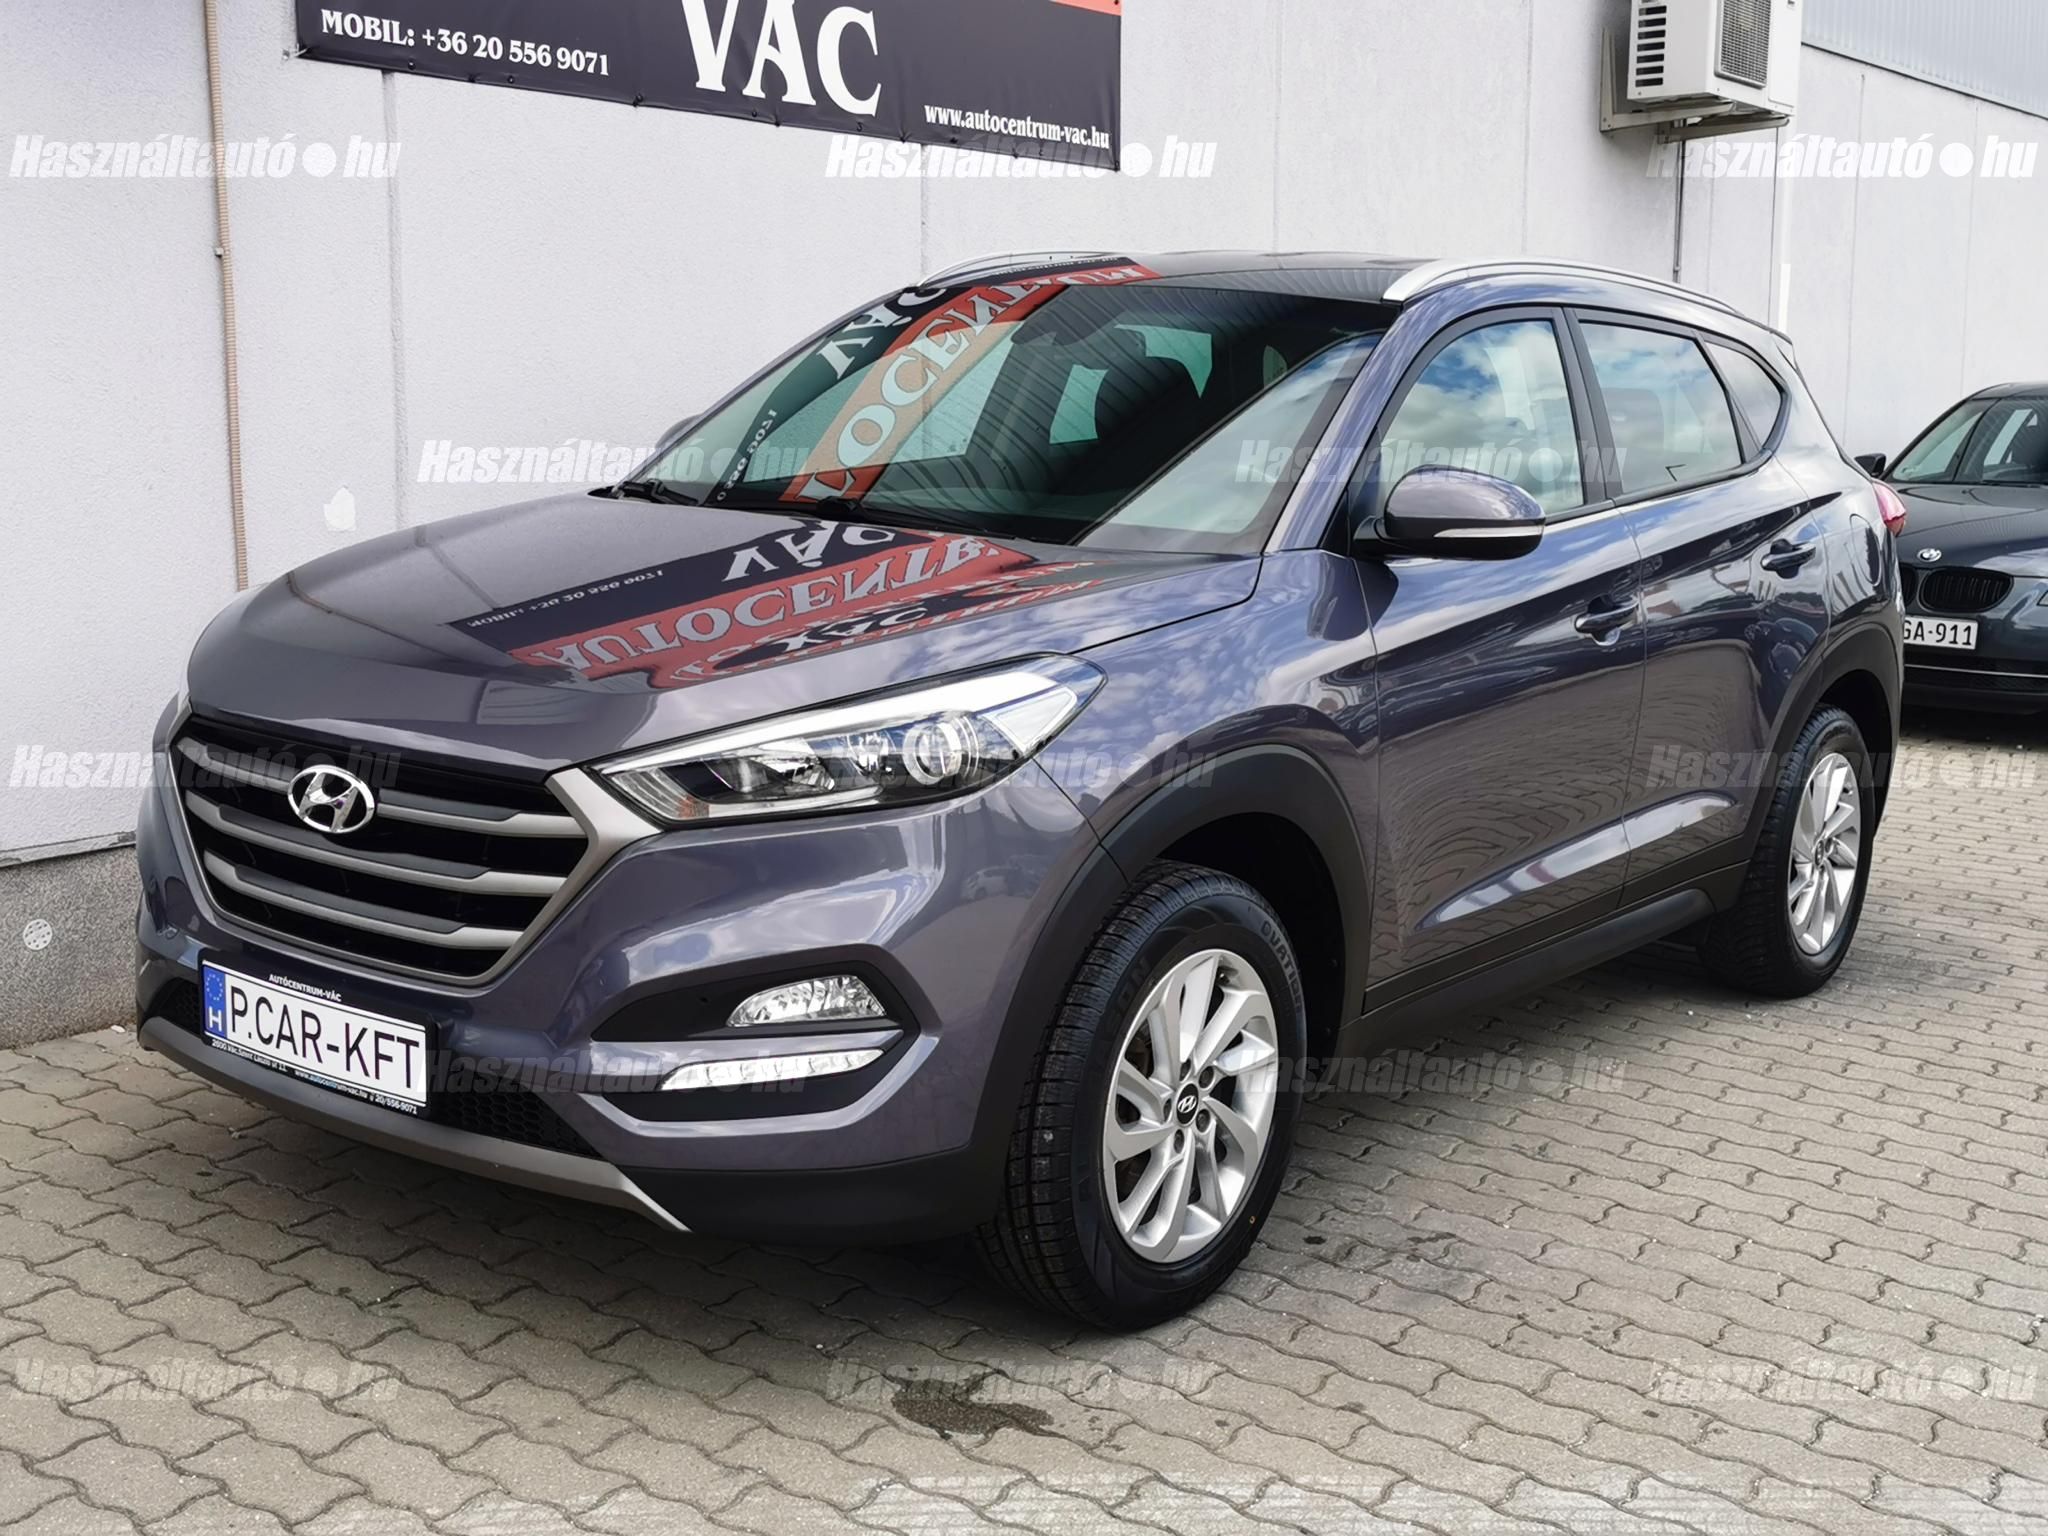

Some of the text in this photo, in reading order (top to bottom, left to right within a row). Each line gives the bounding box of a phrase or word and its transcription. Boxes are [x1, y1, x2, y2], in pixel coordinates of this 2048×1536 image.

[321, 9, 609, 76] MOBIL: +36 20 556 9071
[924, 104, 1110, 149] www.autocentrum-vac.hu
[269, 974, 342, 1002] AUTÓCENTRUM-VÁC
[208, 1006, 223, 1033] H
[231, 985, 420, 1089] P.CAR-KFT
